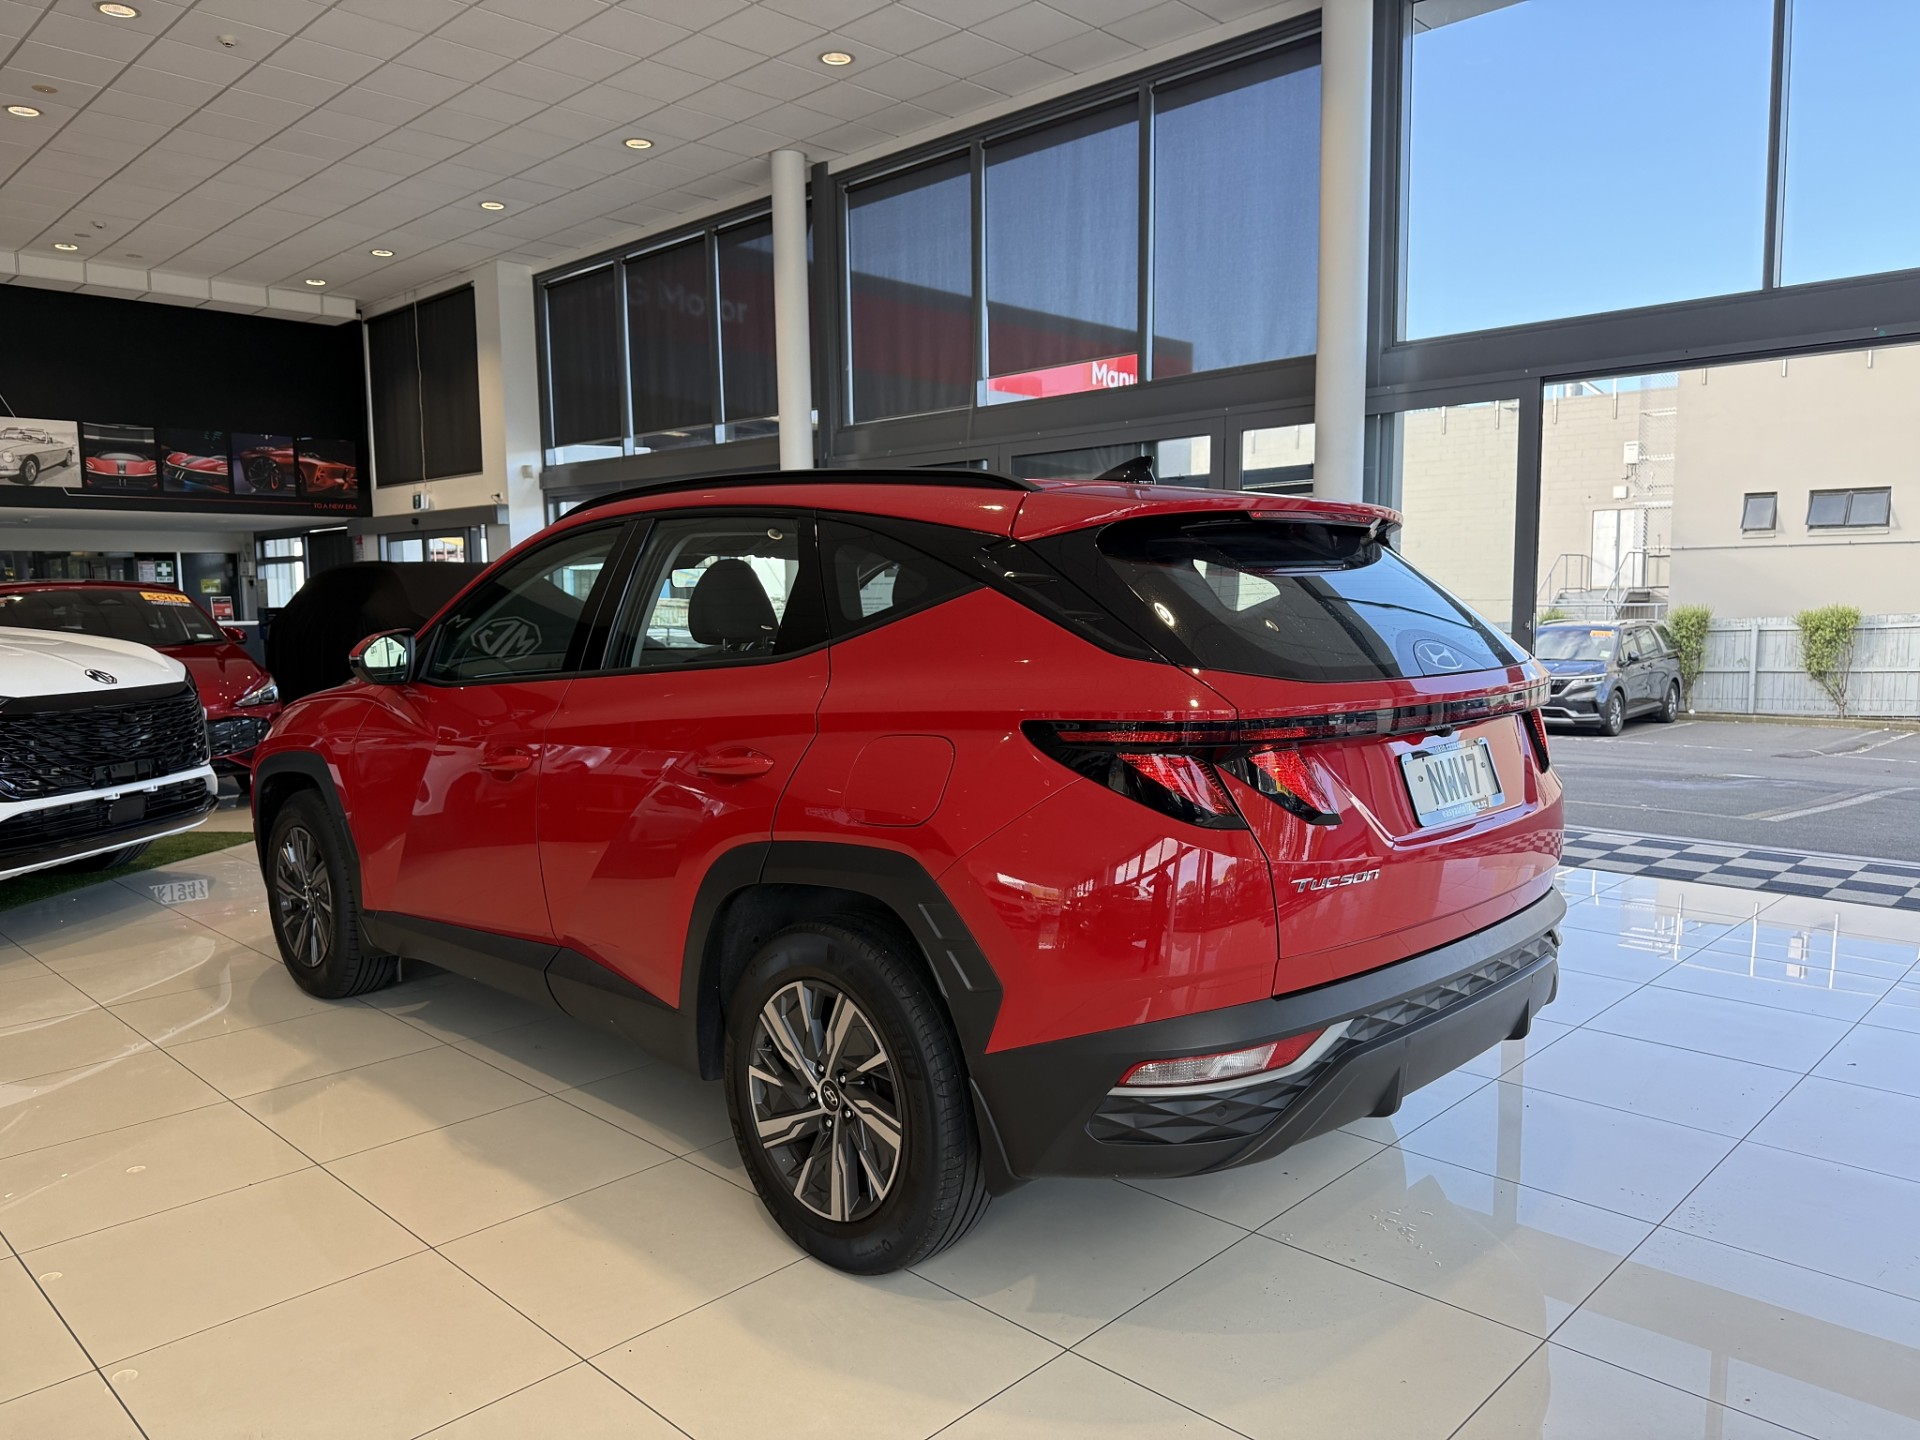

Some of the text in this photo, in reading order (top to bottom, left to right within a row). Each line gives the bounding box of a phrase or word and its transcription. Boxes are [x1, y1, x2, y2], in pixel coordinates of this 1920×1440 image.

[656, 279, 748, 325] Moor
[147, 593, 187, 602] SOLD
[1425, 753, 1481, 805] NWW7
